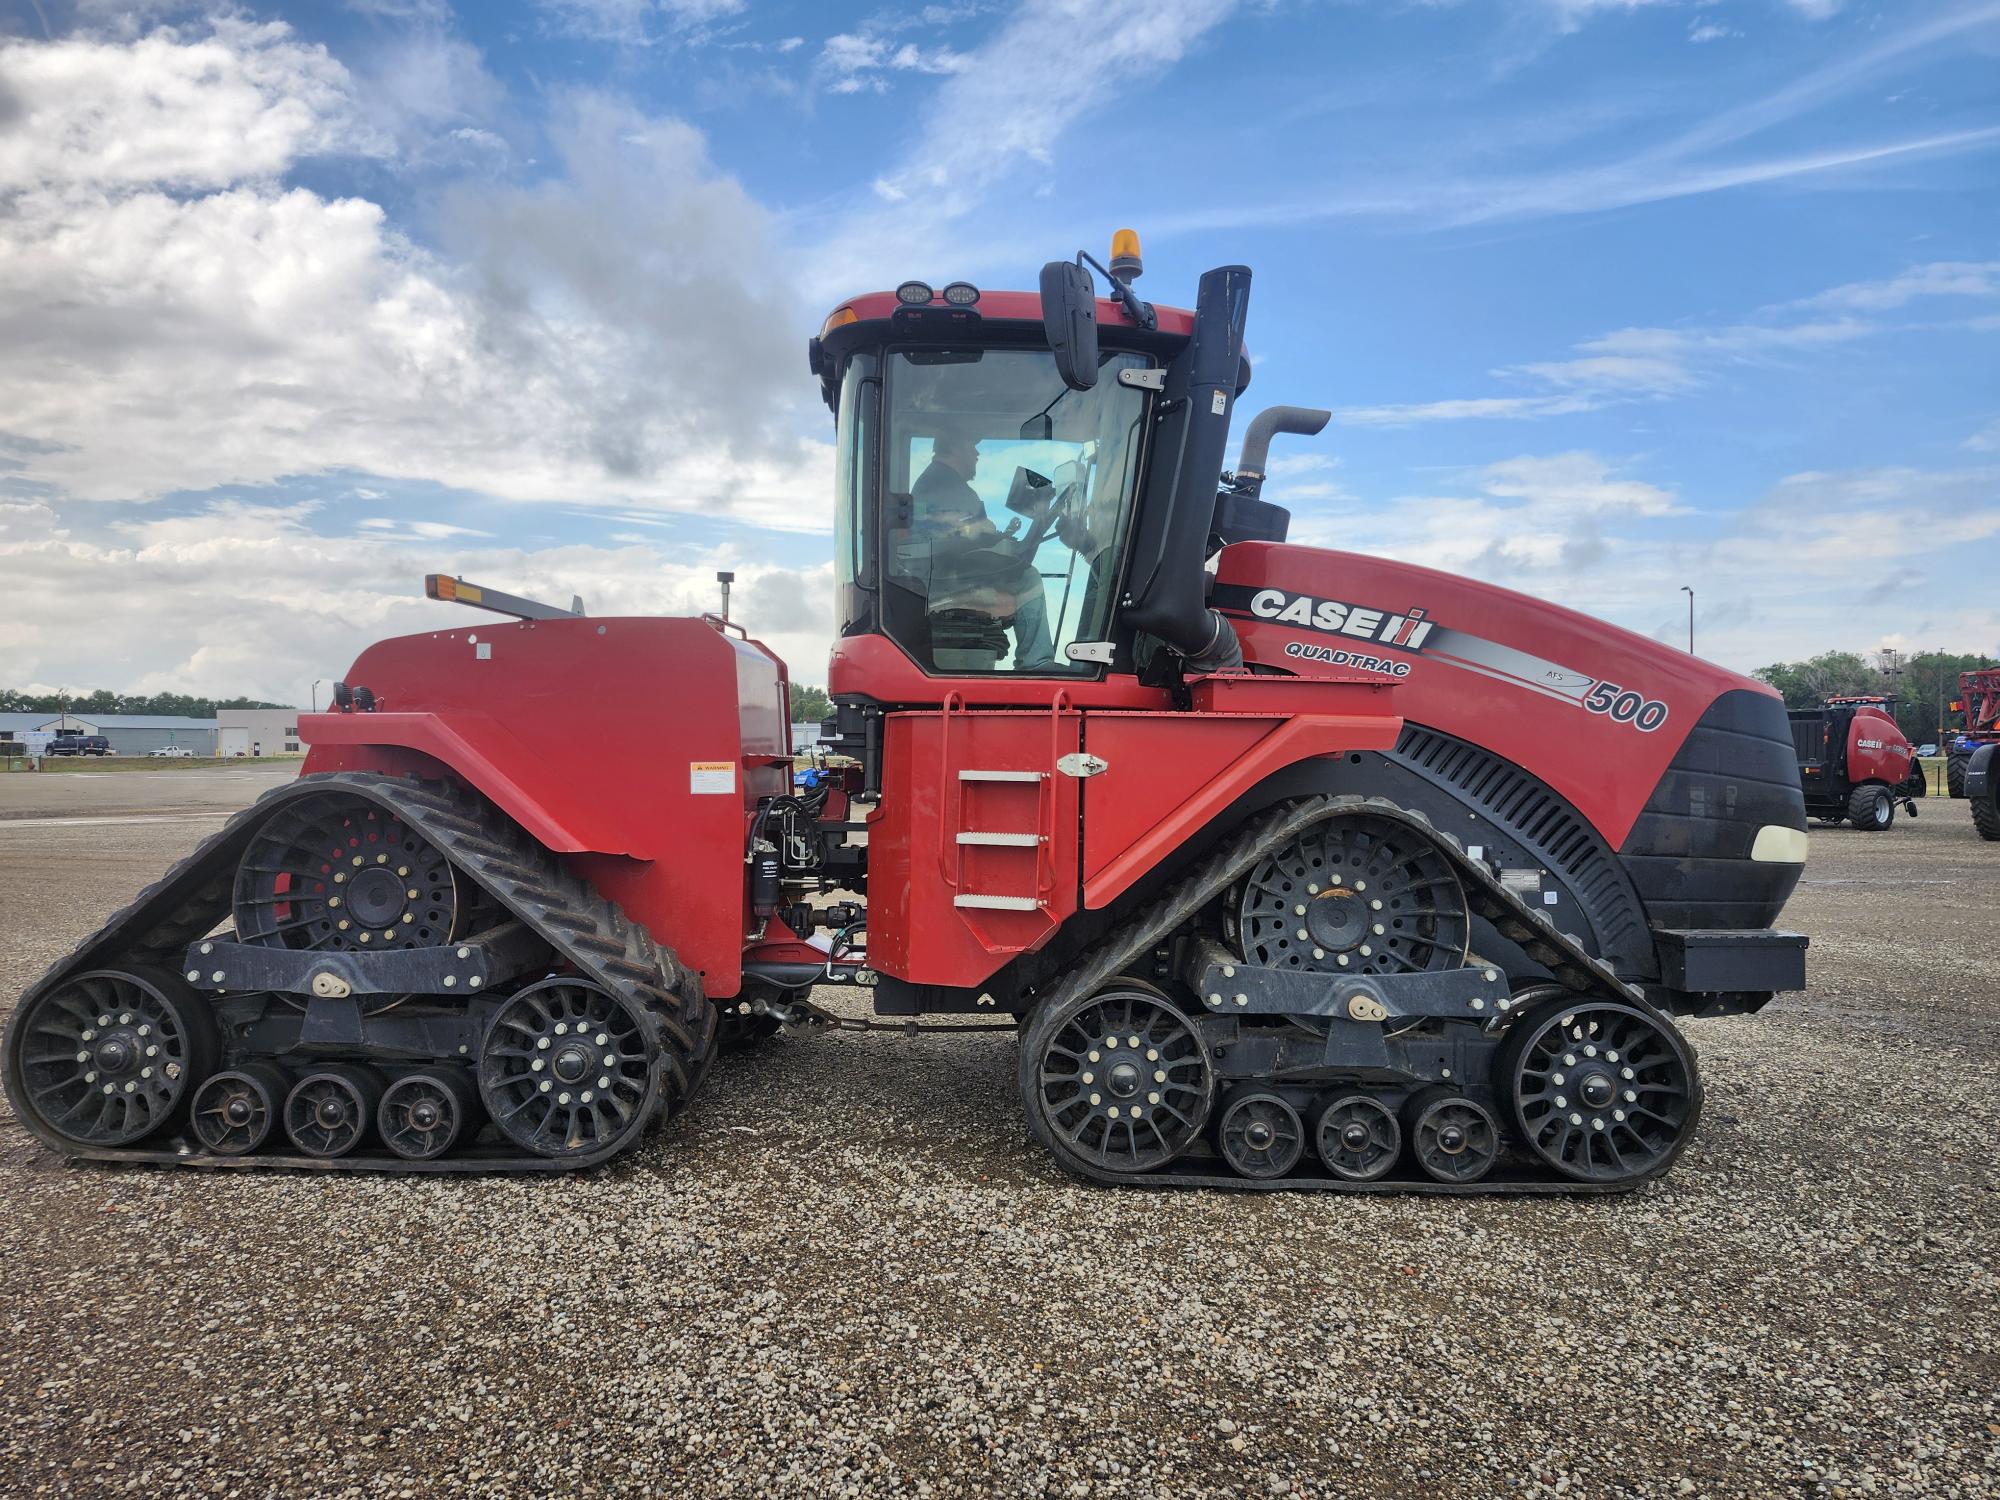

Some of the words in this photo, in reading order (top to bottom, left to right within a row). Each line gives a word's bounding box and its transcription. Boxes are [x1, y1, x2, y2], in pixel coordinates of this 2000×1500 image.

[1251, 589, 1384, 638] CASE
[1285, 642, 1411, 677] QUADTRAC
[1546, 671, 1564, 681] AFS
[1583, 680, 1669, 732] 500
[1857, 739, 1876, 748] CASE
